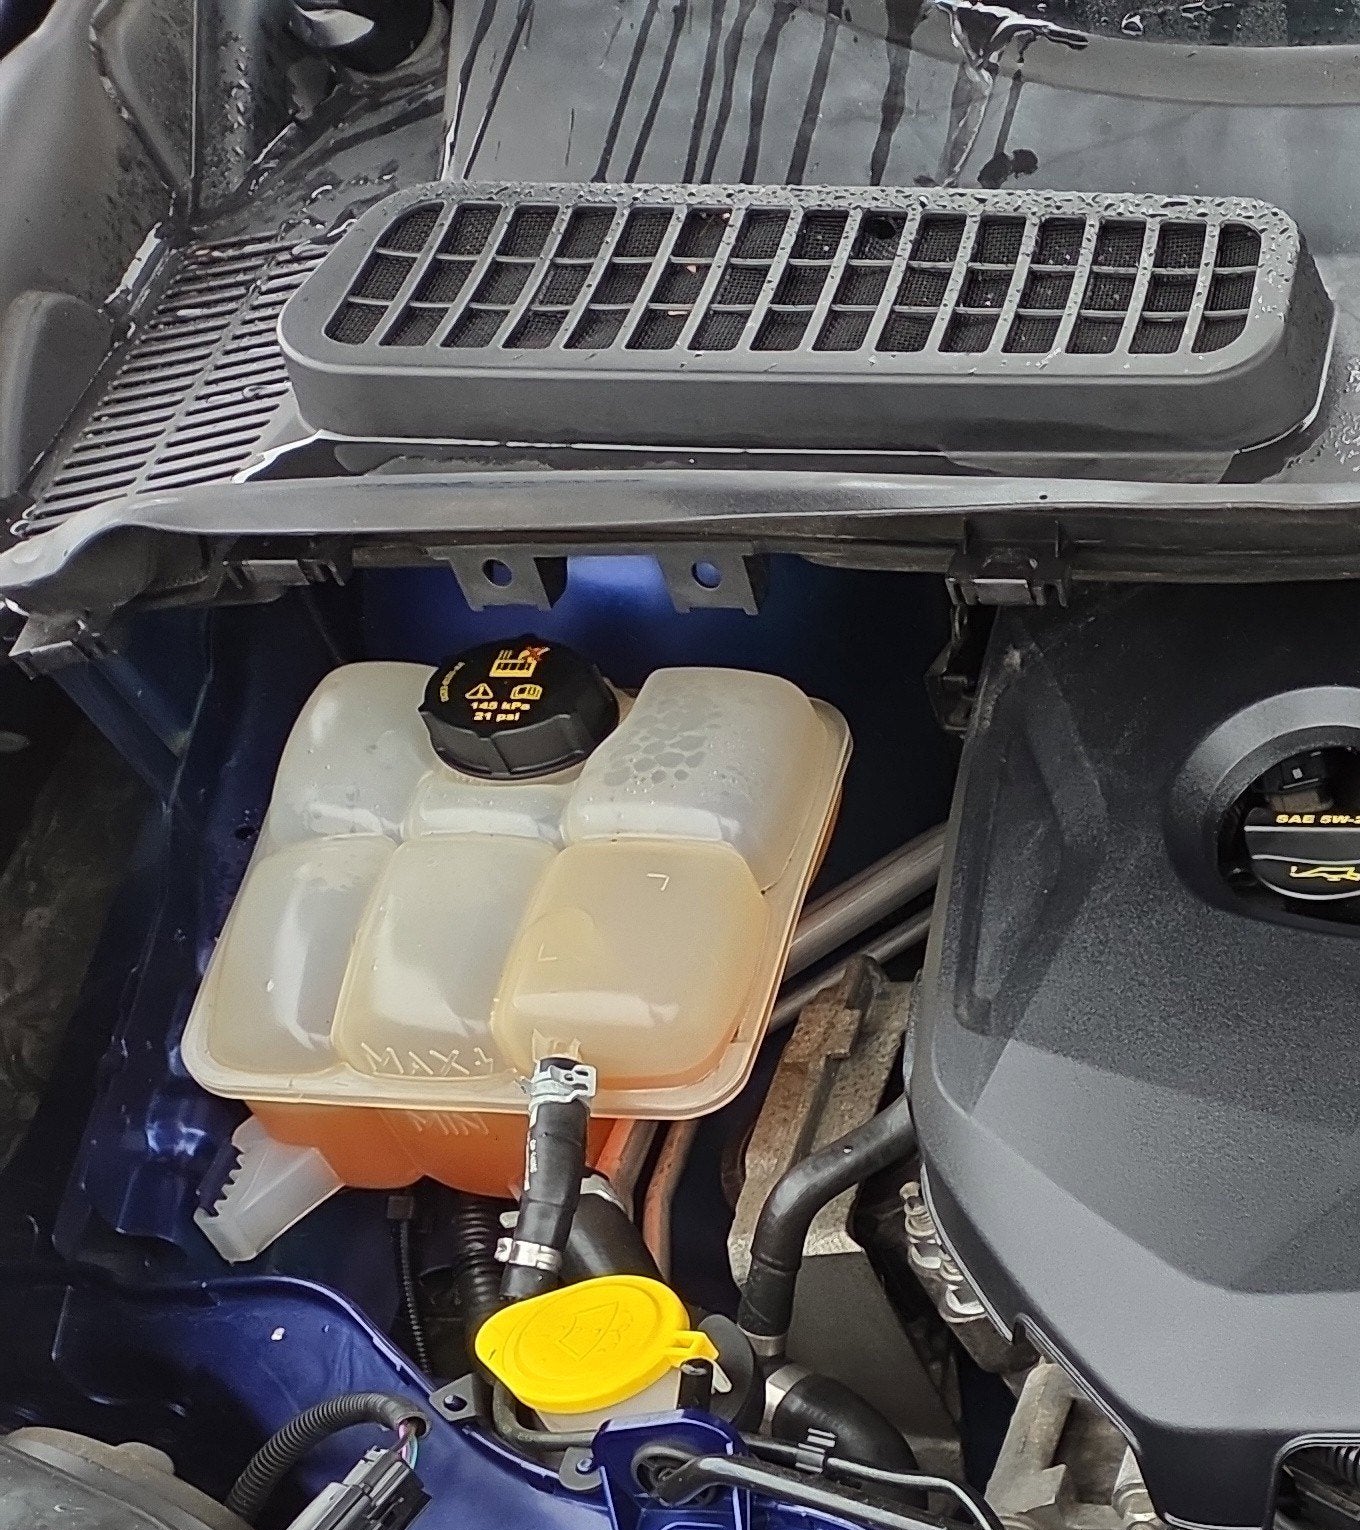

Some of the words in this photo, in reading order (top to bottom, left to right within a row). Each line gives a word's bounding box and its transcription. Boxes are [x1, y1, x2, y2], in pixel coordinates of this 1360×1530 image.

[474, 712, 492, 720] 21
[496, 712, 520, 722] psi
[1276, 815, 1315, 824] SAE
[360, 1042, 470, 1075] MAX
